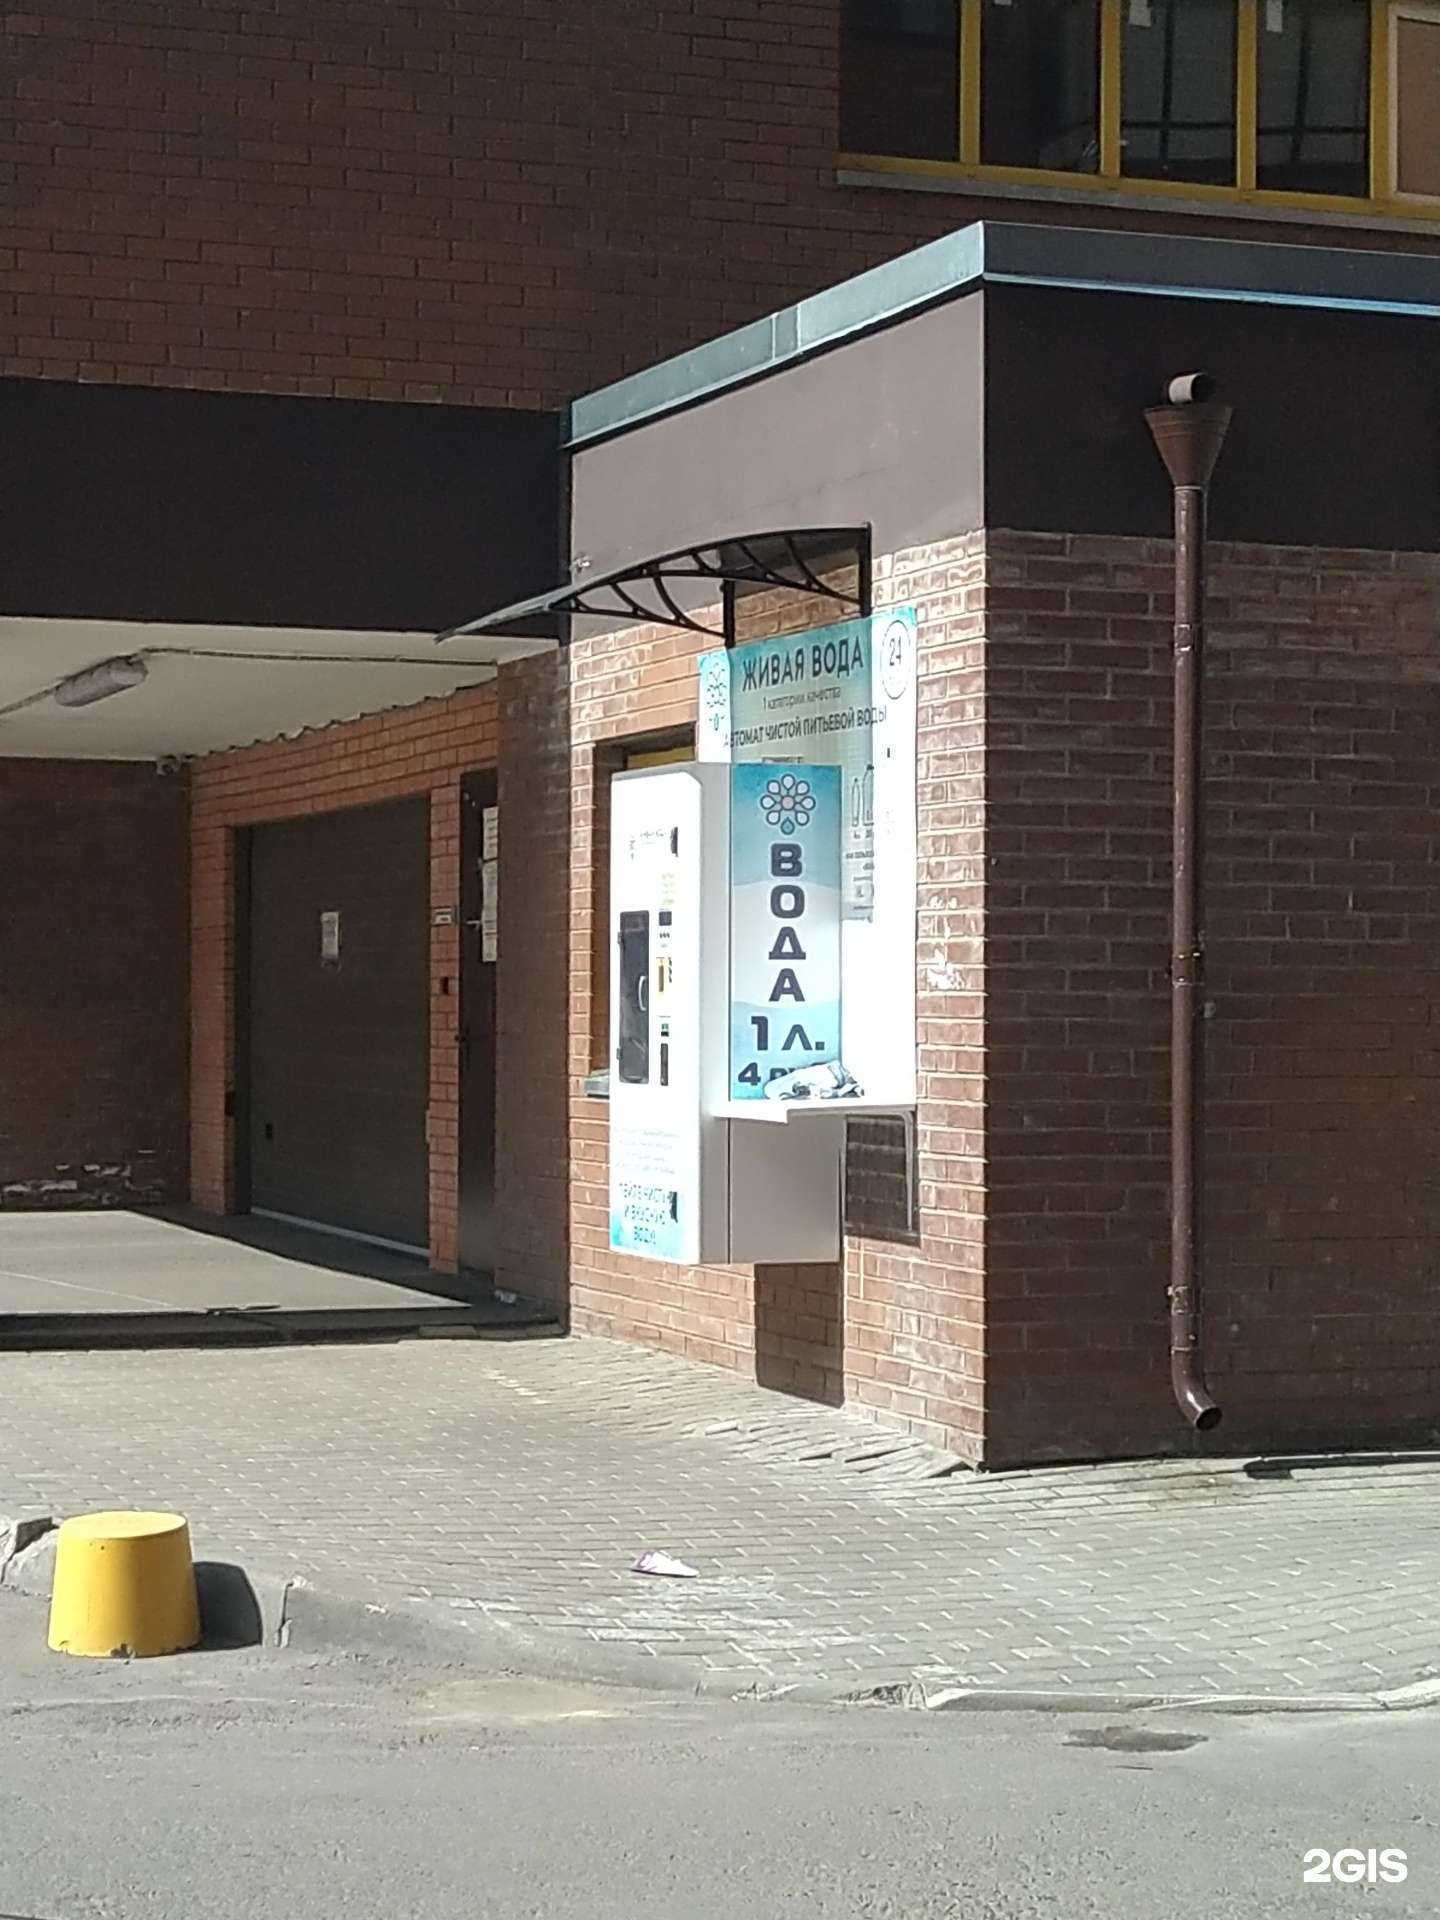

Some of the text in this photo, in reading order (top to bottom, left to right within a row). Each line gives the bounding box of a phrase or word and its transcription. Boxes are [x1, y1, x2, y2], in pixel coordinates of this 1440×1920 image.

[742, 635, 864, 692] ЖИВАЯ ВОДА
[888, 636, 902, 667] 24
[764, 716, 801, 742] ЧИСТОЙ
[803, 706, 855, 736] ПИТЬЕВОЙ
[857, 705, 887, 727] ВОДЫ
[768, 843, 806, 1002] ВОДА
[751, 1015, 769, 1051] 1
[738, 1062, 761, 1086] 4
